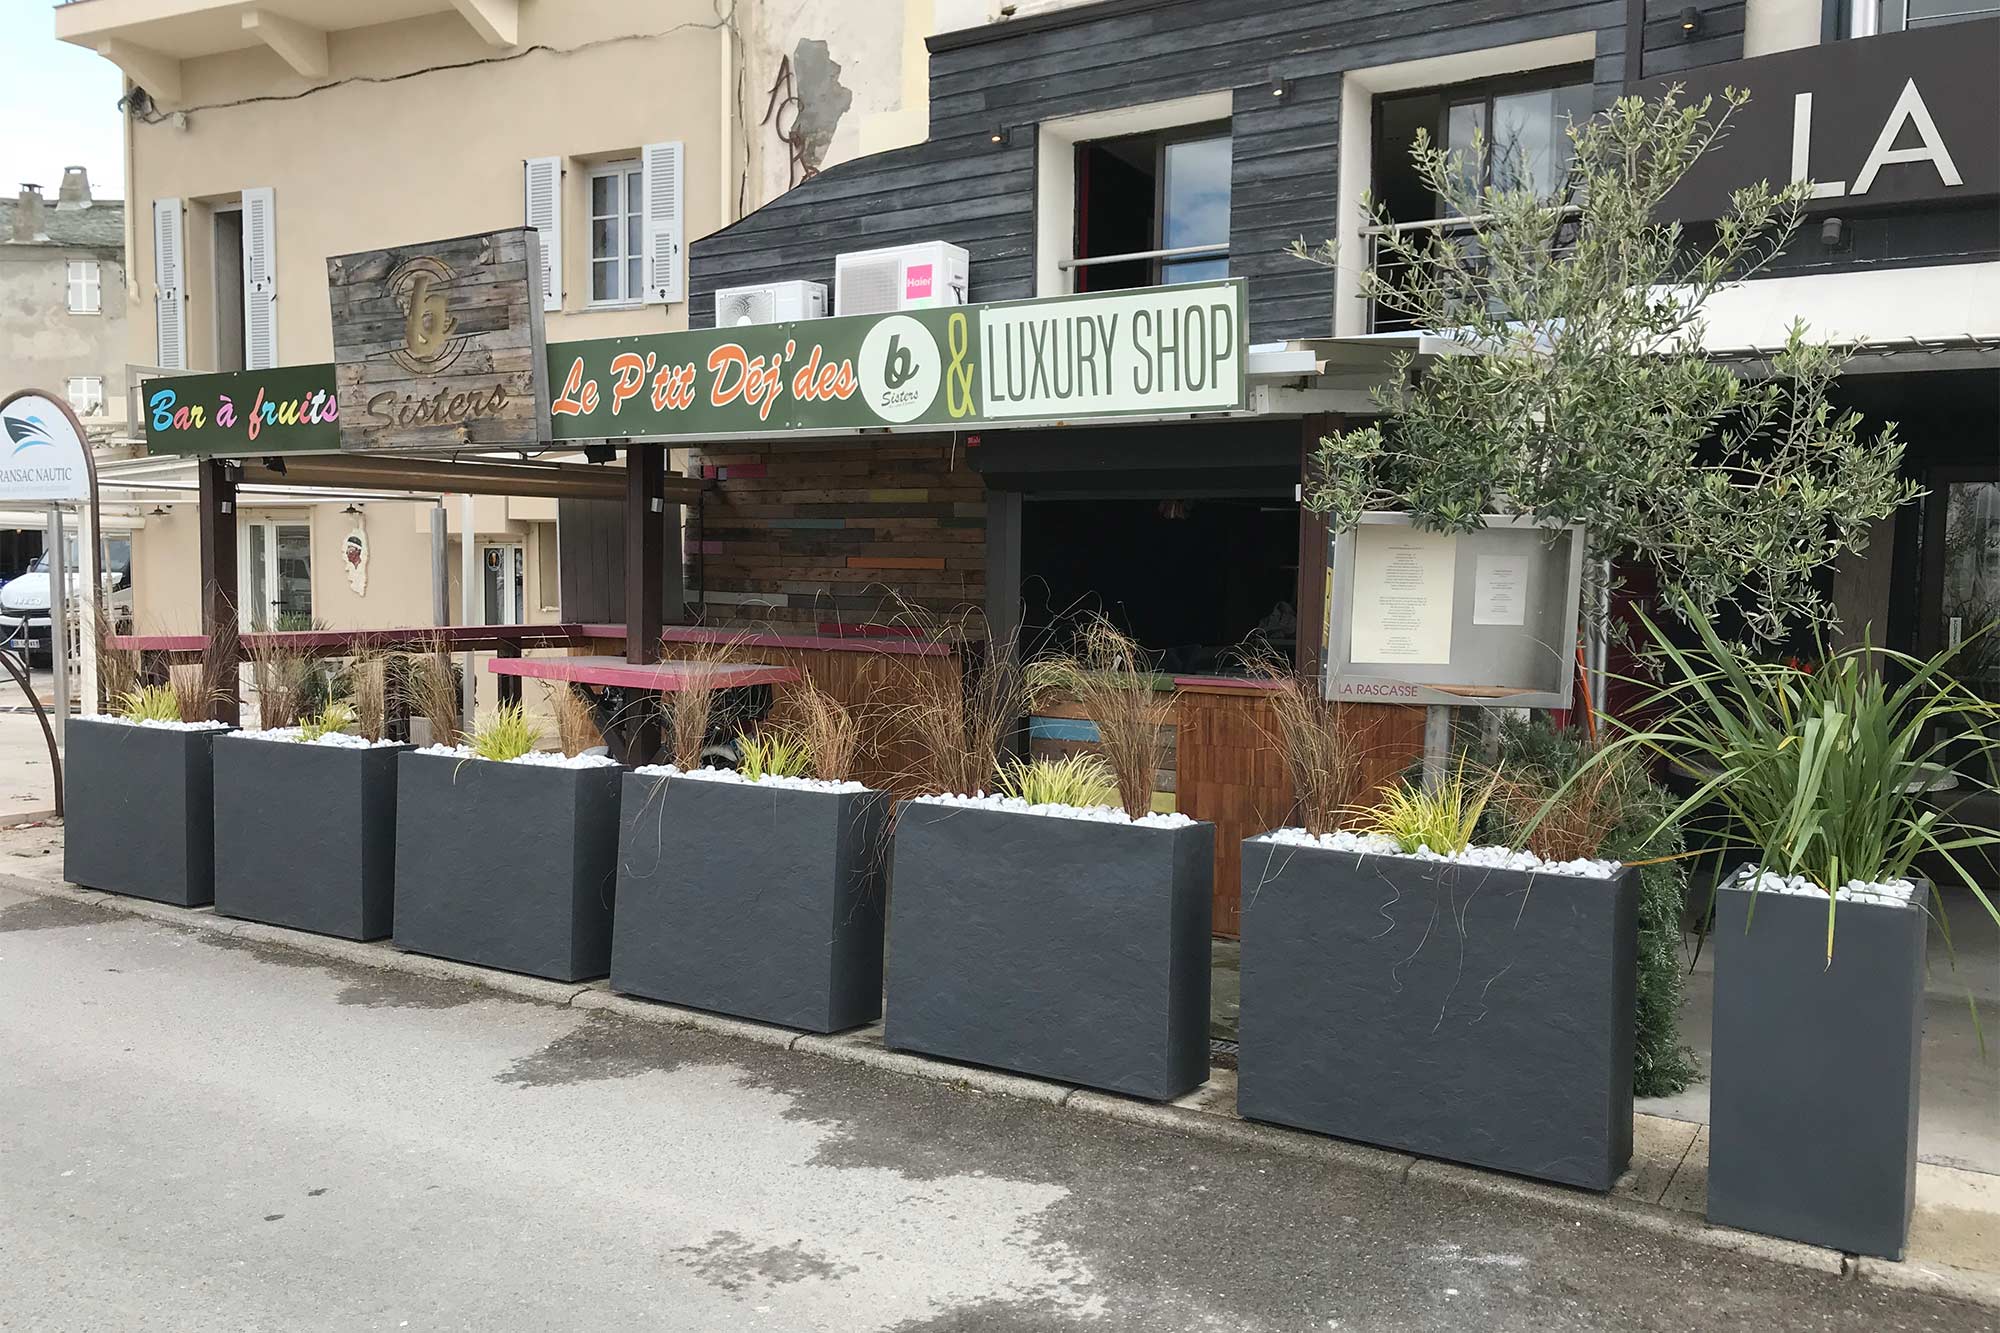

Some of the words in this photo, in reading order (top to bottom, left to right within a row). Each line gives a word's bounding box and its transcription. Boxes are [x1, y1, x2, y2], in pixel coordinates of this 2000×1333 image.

[1791, 77, 1964, 199] LA
[907, 277, 932, 288] Haier
[946, 312, 977, 418] &
[987, 311, 1119, 403] LUXURY
[1132, 302, 1234, 395] SHOP
[363, 383, 509, 436] Sisters
[551, 356, 601, 416] Le
[609, 351, 696, 416] P'tit
[881, 390, 919, 407] Sisters
[150, 389, 206, 432] Bar
[216, 395, 237, 428] à
[248, 387, 339, 440] fruits
[36, 467, 73, 481] NAUTIC
[1338, 683, 1353, 694] LA
[1356, 684, 1419, 697] RASCASSE
